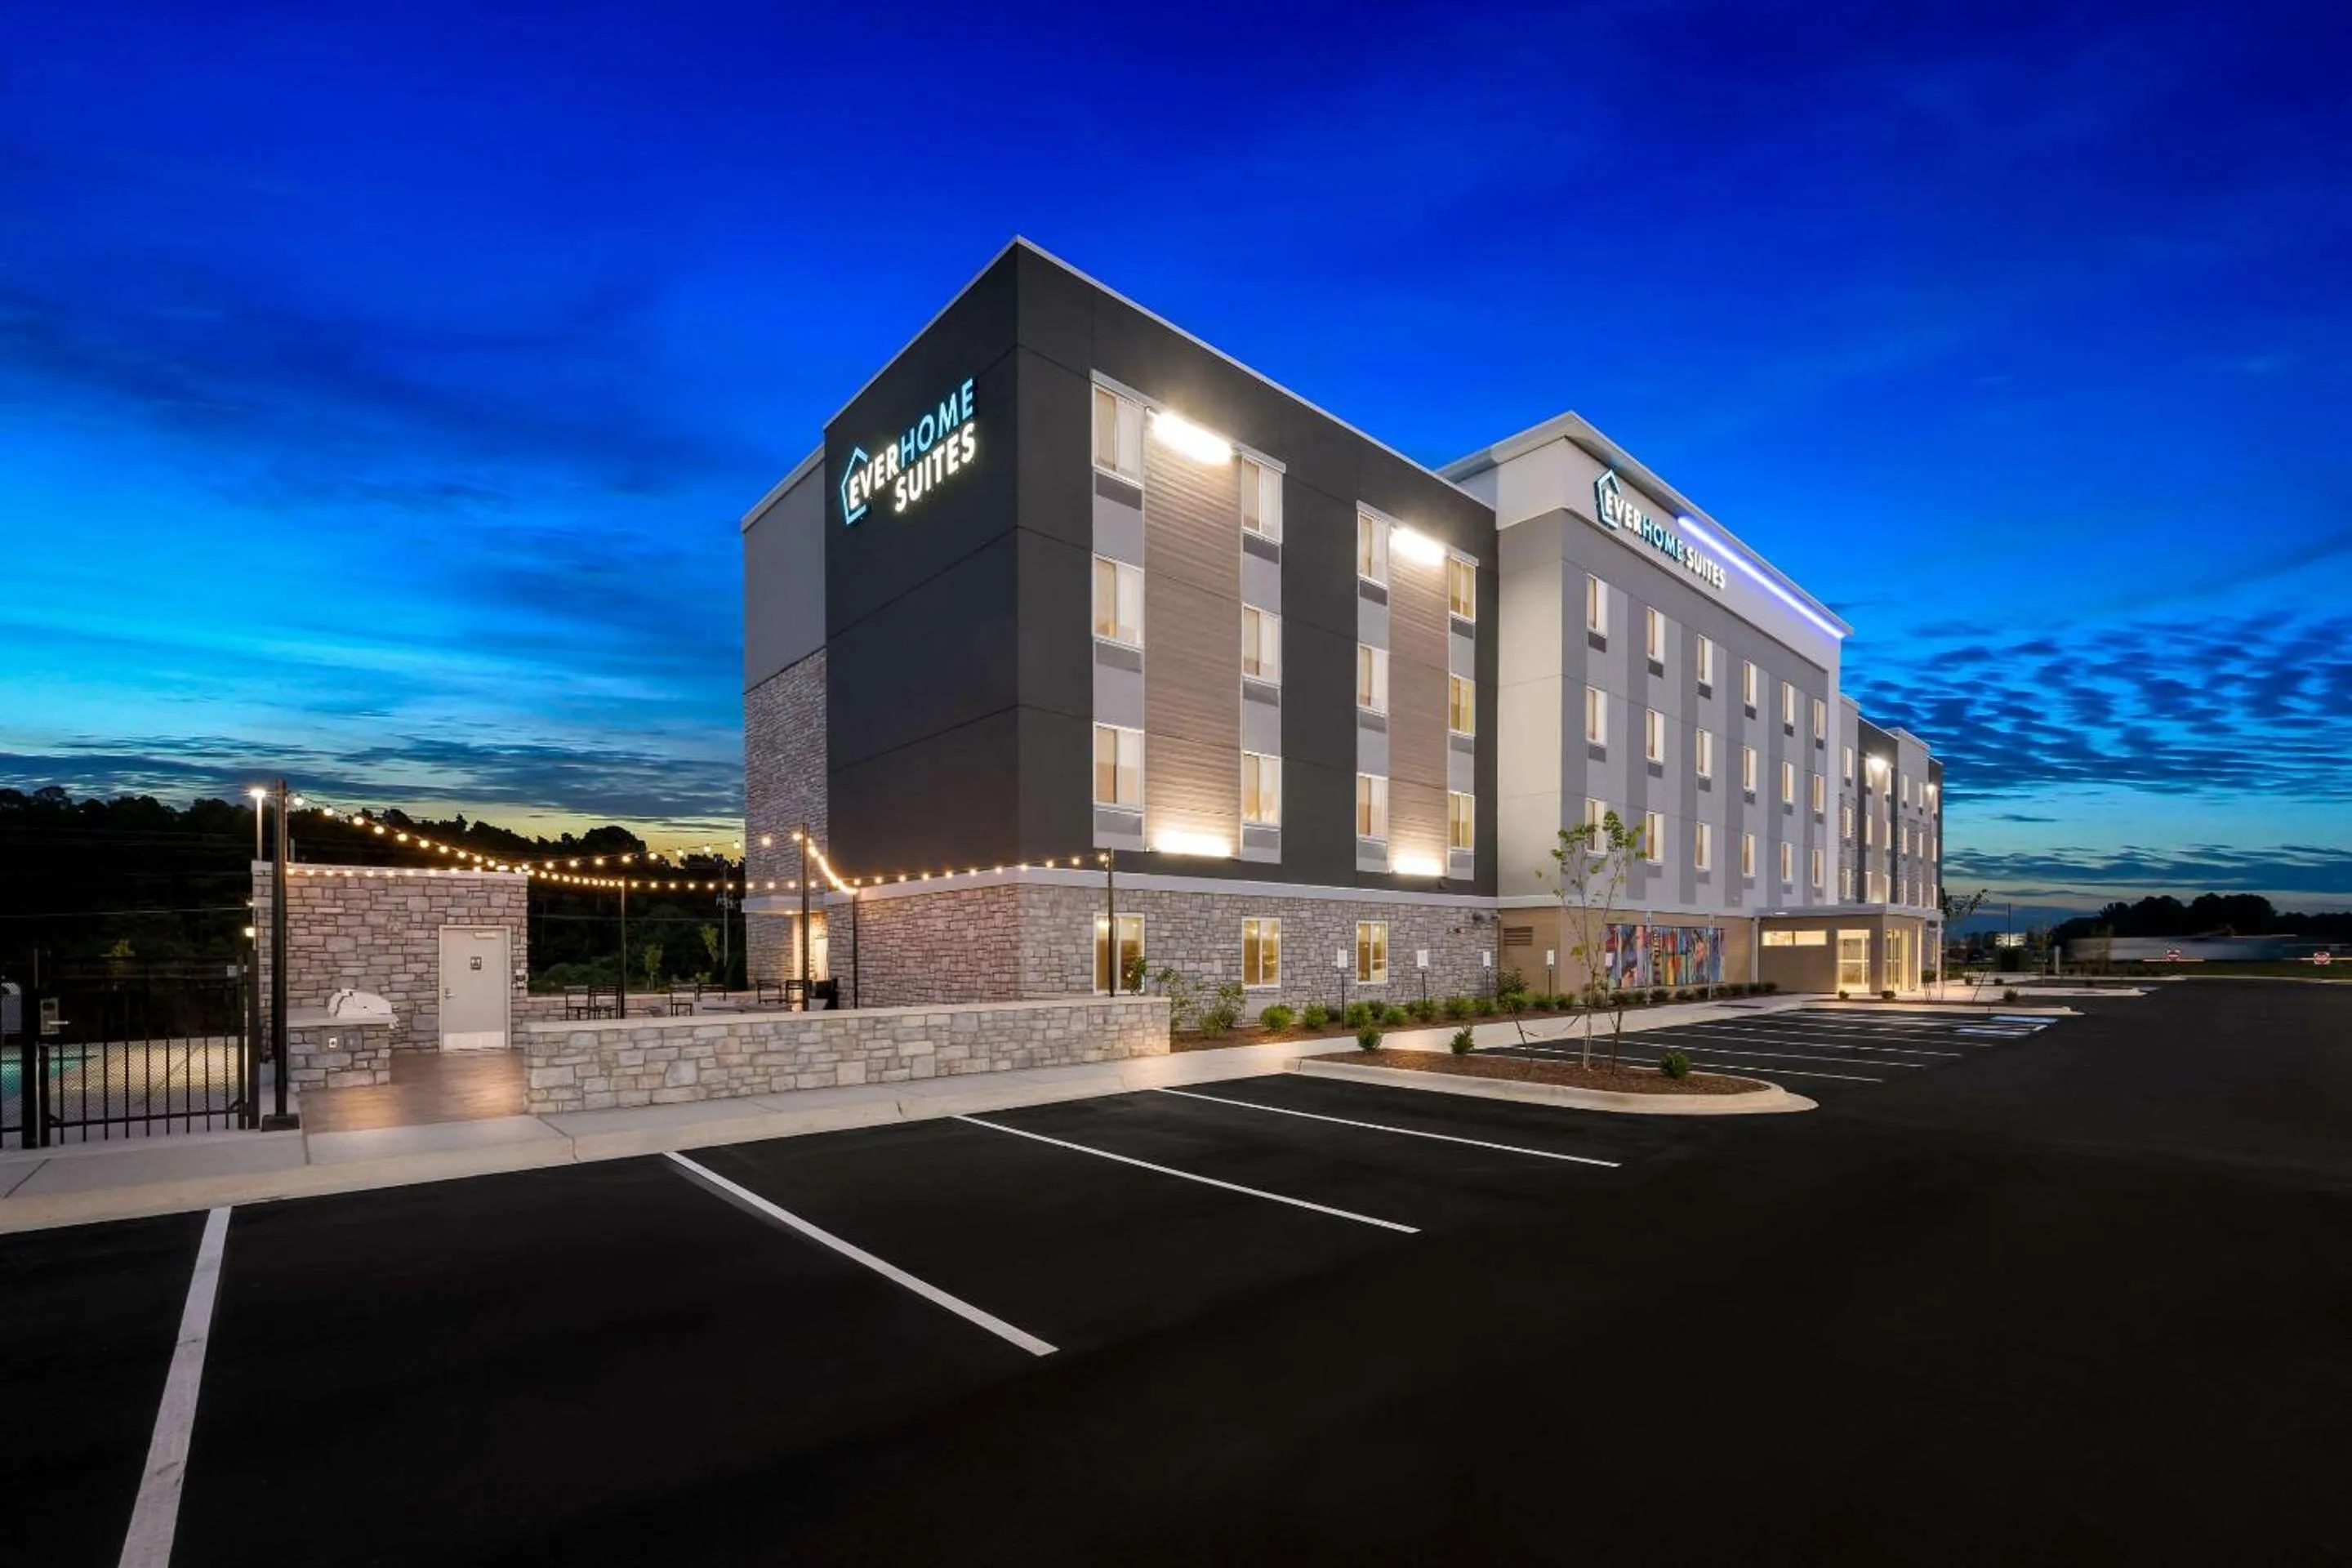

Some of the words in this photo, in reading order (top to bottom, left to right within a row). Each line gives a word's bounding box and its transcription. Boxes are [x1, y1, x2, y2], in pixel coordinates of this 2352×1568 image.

[849, 378, 973, 510] EVERHOME
[894, 422, 976, 512] SUITES
[1605, 489, 1684, 561] EVERHOME
[1686, 546, 1726, 589] SUITES
